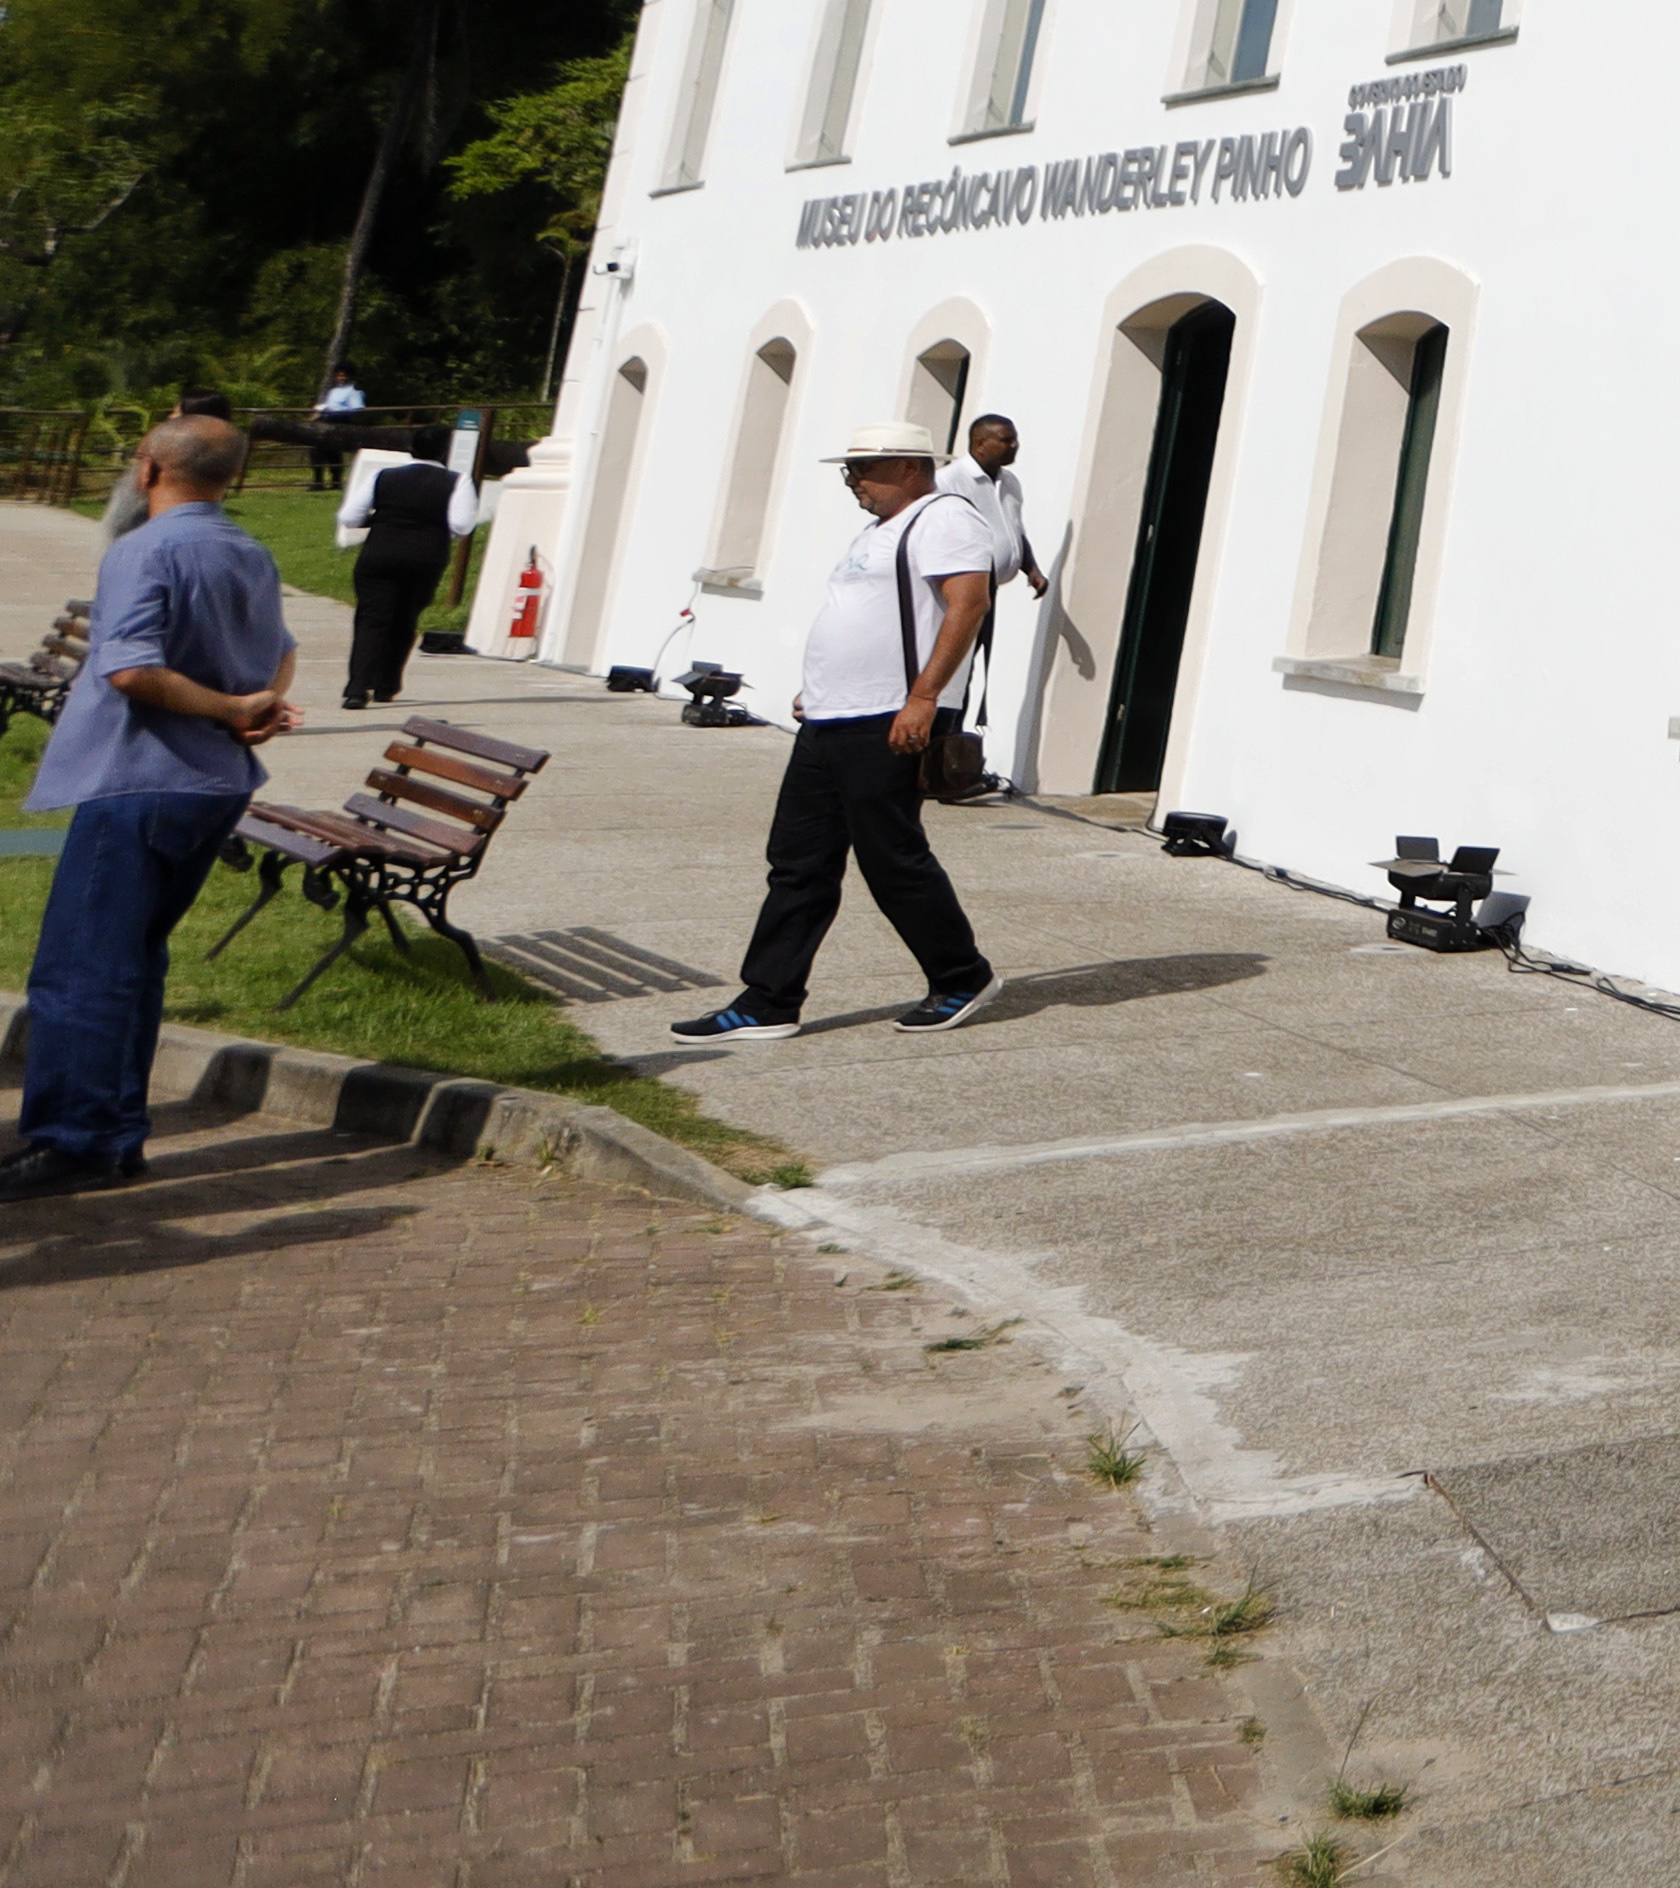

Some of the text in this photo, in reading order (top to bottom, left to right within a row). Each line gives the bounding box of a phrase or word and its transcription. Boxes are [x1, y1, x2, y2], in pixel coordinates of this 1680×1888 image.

[796, 126, 1312, 249] MUSEU DO RECÔNCAVO WANDERLEY PINHO
